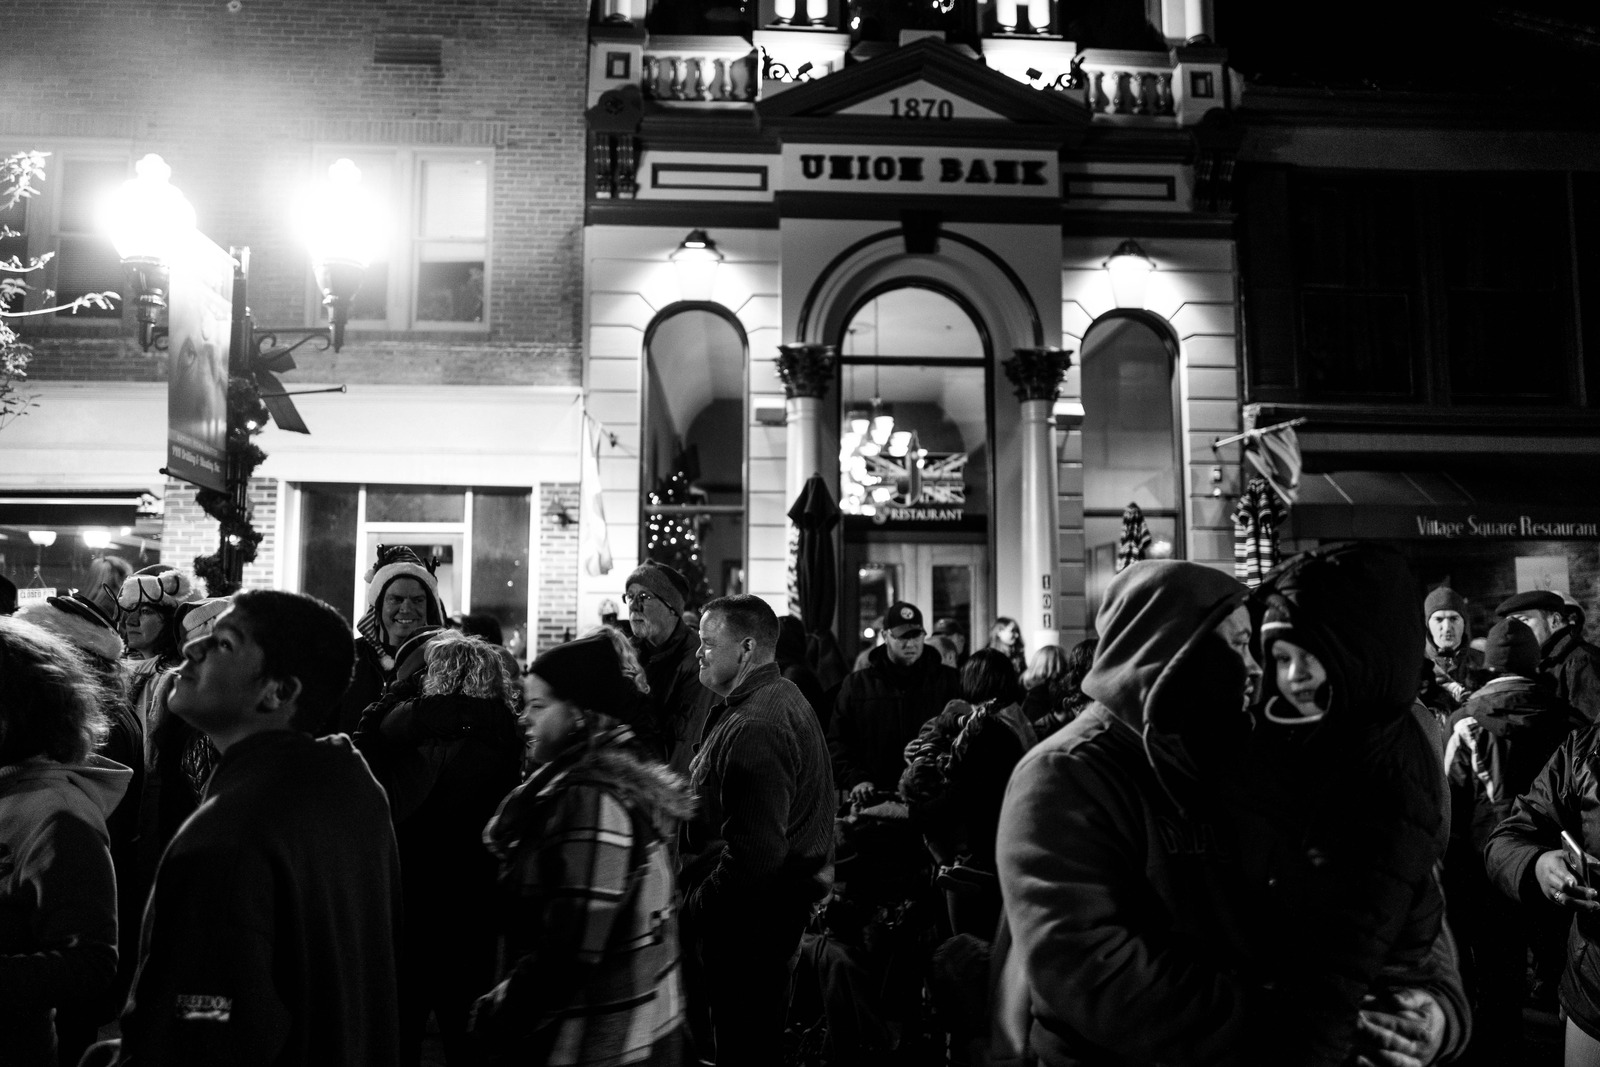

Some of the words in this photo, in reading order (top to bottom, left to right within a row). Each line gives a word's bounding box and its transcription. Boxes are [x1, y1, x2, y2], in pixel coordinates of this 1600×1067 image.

[889, 98, 954, 121] 1870
[800, 154, 924, 182] UNION
[939, 157, 1048, 186] BANK
[890, 508, 964, 521] RESTAURANT
[1416, 515, 1464, 538] Village
[1467, 515, 1517, 538] Square
[1520, 515, 1598, 537] Restaurant
